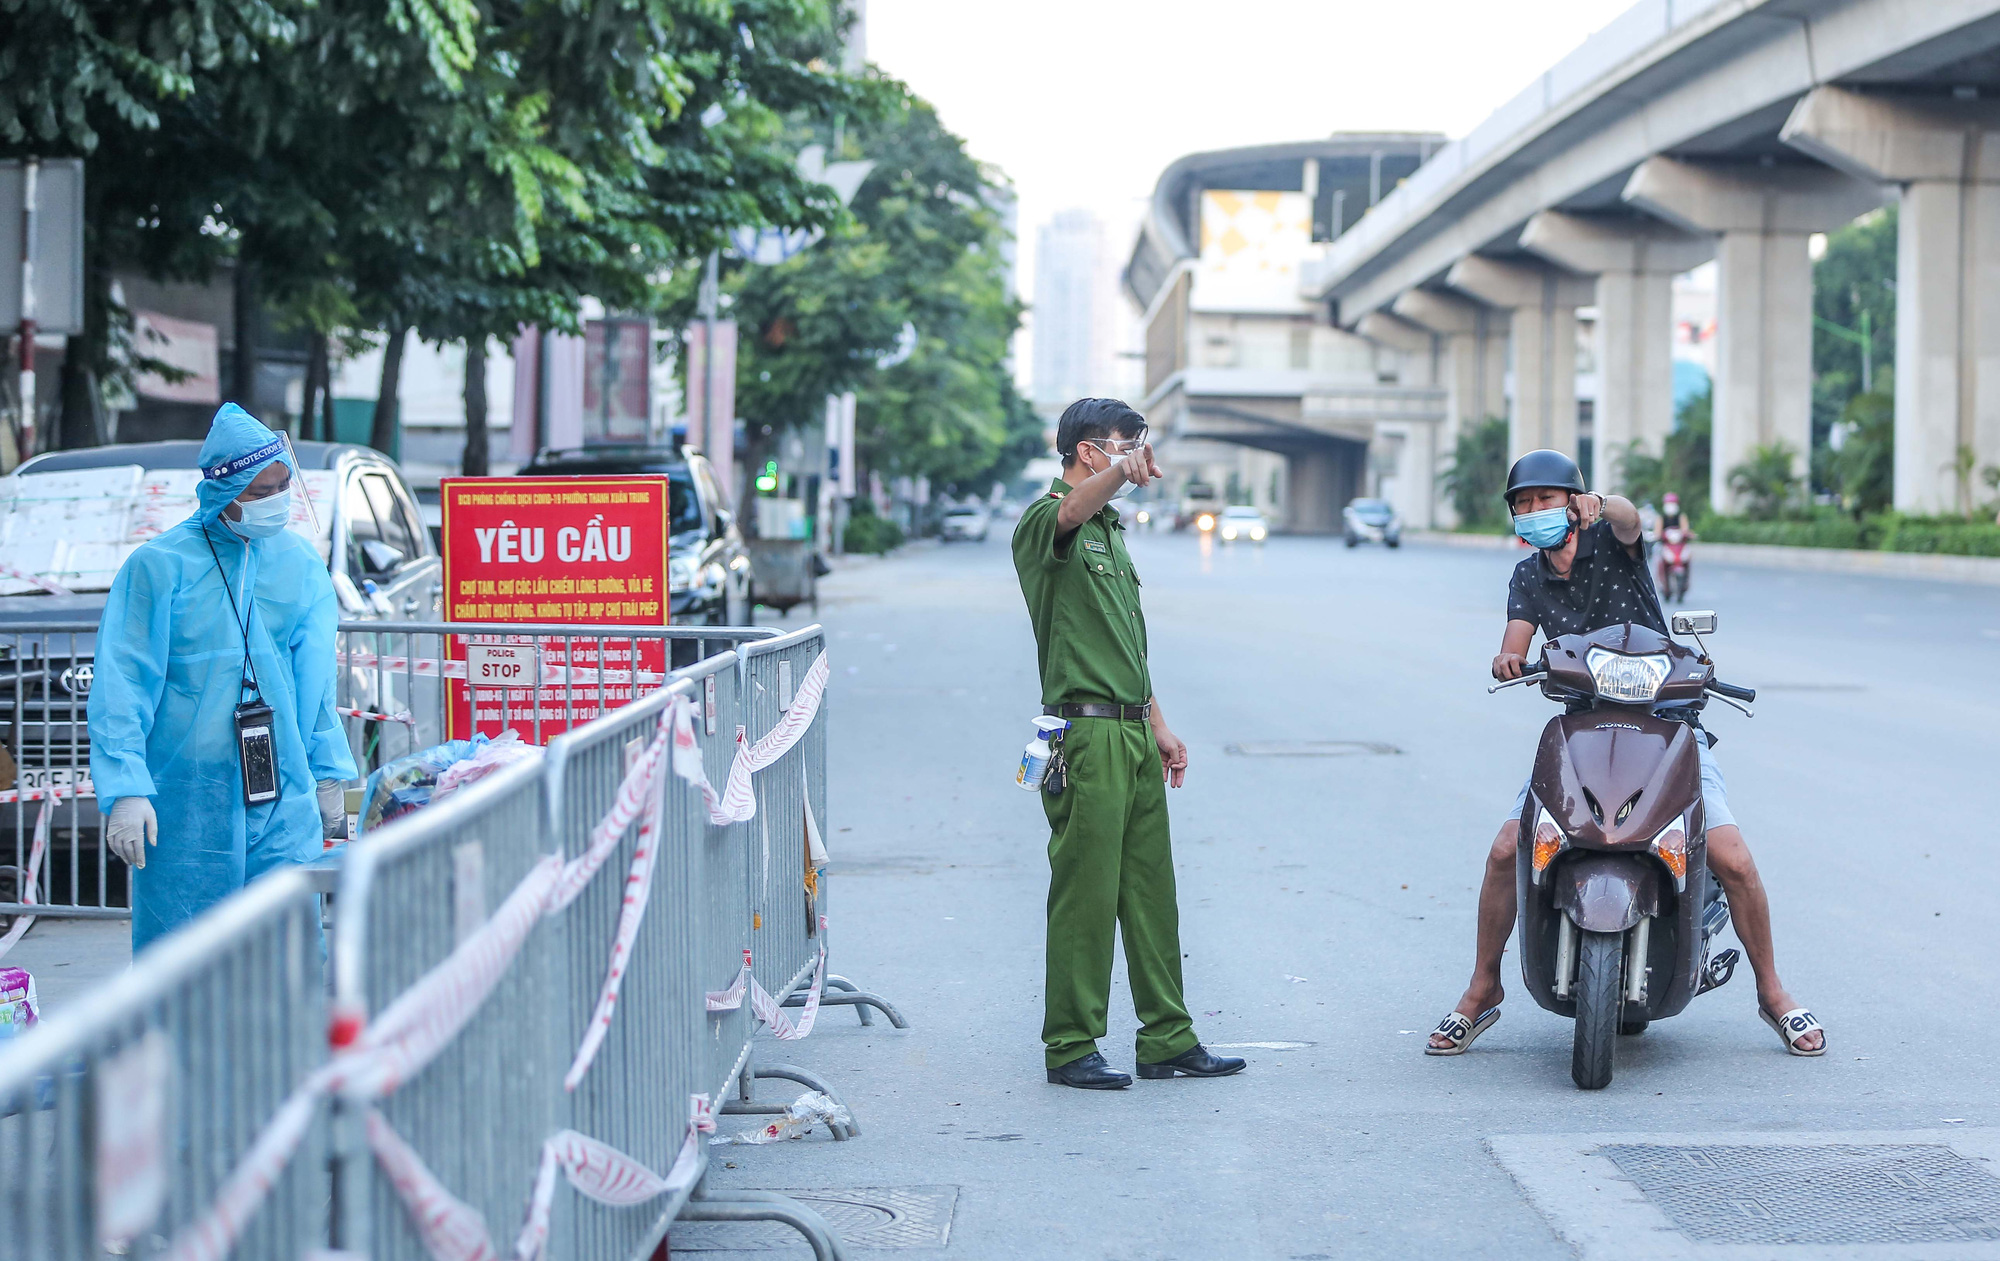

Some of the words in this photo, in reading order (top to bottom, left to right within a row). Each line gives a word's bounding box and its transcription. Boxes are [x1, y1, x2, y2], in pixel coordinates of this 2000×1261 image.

[233, 443, 278, 469] PROTECTION
[472, 491, 494, 505] PHÒNG
[495, 490, 516, 505] CHỐNG
[517, 493, 532, 507] DỊCH
[533, 493, 561, 504] COVID-19
[562, 490, 588, 504] PHƯỜNG
[588, 492, 609, 504] THANH
[610, 490, 628, 504] XUÂN
[628, 491, 650, 504] TRUNG
[474, 520, 545, 563] YÊU
[557, 514, 632, 563] CẦU
[460, 579, 476, 598] CHỢ
[478, 580, 497, 598] TẠM,
[498, 579, 515, 598] CHỢ
[515, 577, 532, 594] CÓC
[532, 575, 549, 594] LẤN
[549, 575, 575, 594] CHIẾM
[575, 576, 597, 594] LÒNG
[455, 599, 477, 618] CHẤM
[493, 603, 513, 620] HOẠT
[537, 600, 562, 618] KHÔNG
[562, 602, 573, 620] TỤ
[589, 602, 605, 620] HỌP
[605, 601, 621, 620] CHỢ
[621, 599, 639, 616] TRÁI
[639, 598, 659, 616] PHÉP
[487, 649, 515, 658] POLICE
[482, 663, 521, 678] STOP
[1595, 722, 1642, 731] HONDA
